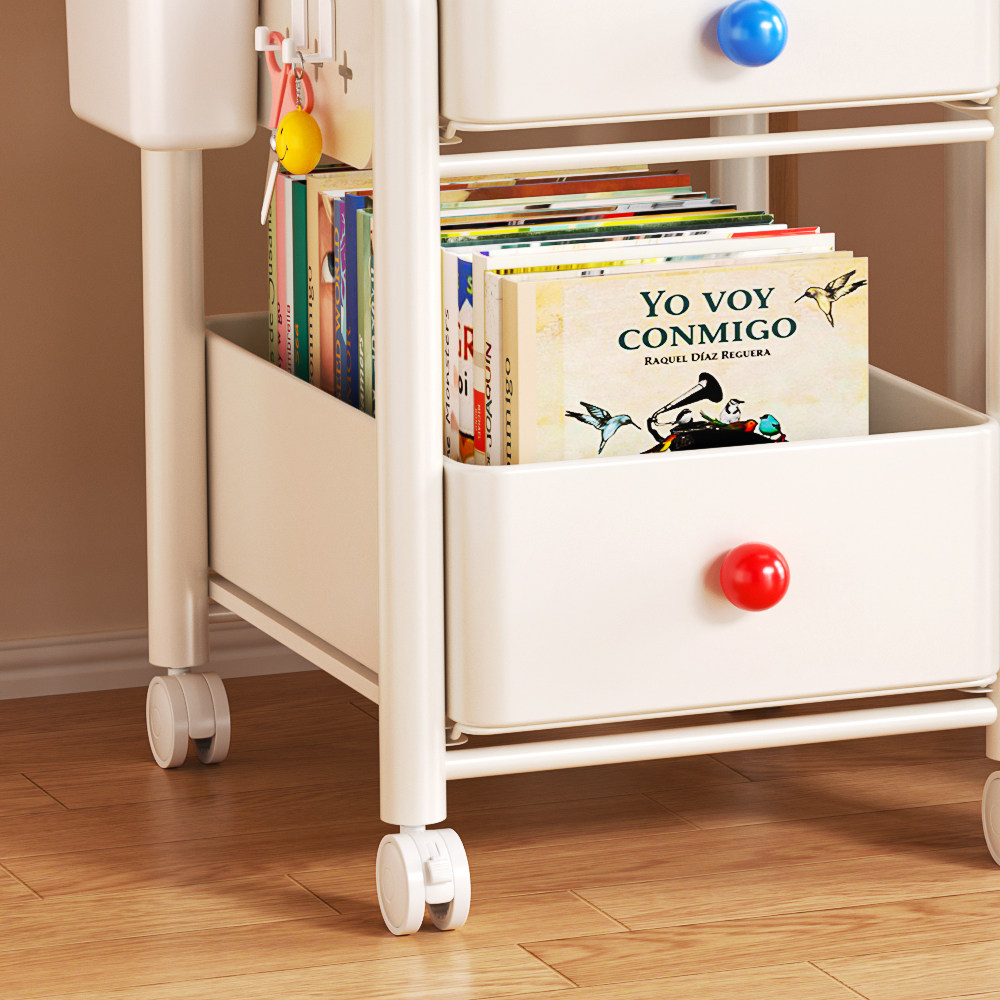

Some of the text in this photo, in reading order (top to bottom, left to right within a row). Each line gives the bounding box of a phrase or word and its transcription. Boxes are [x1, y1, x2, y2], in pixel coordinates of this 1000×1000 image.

[702, 286, 776, 313] VOY
[618, 316, 798, 351] CONMIGO
[644, 354, 689, 366] RAQUEL
[721, 347, 771, 361] REGUERA
